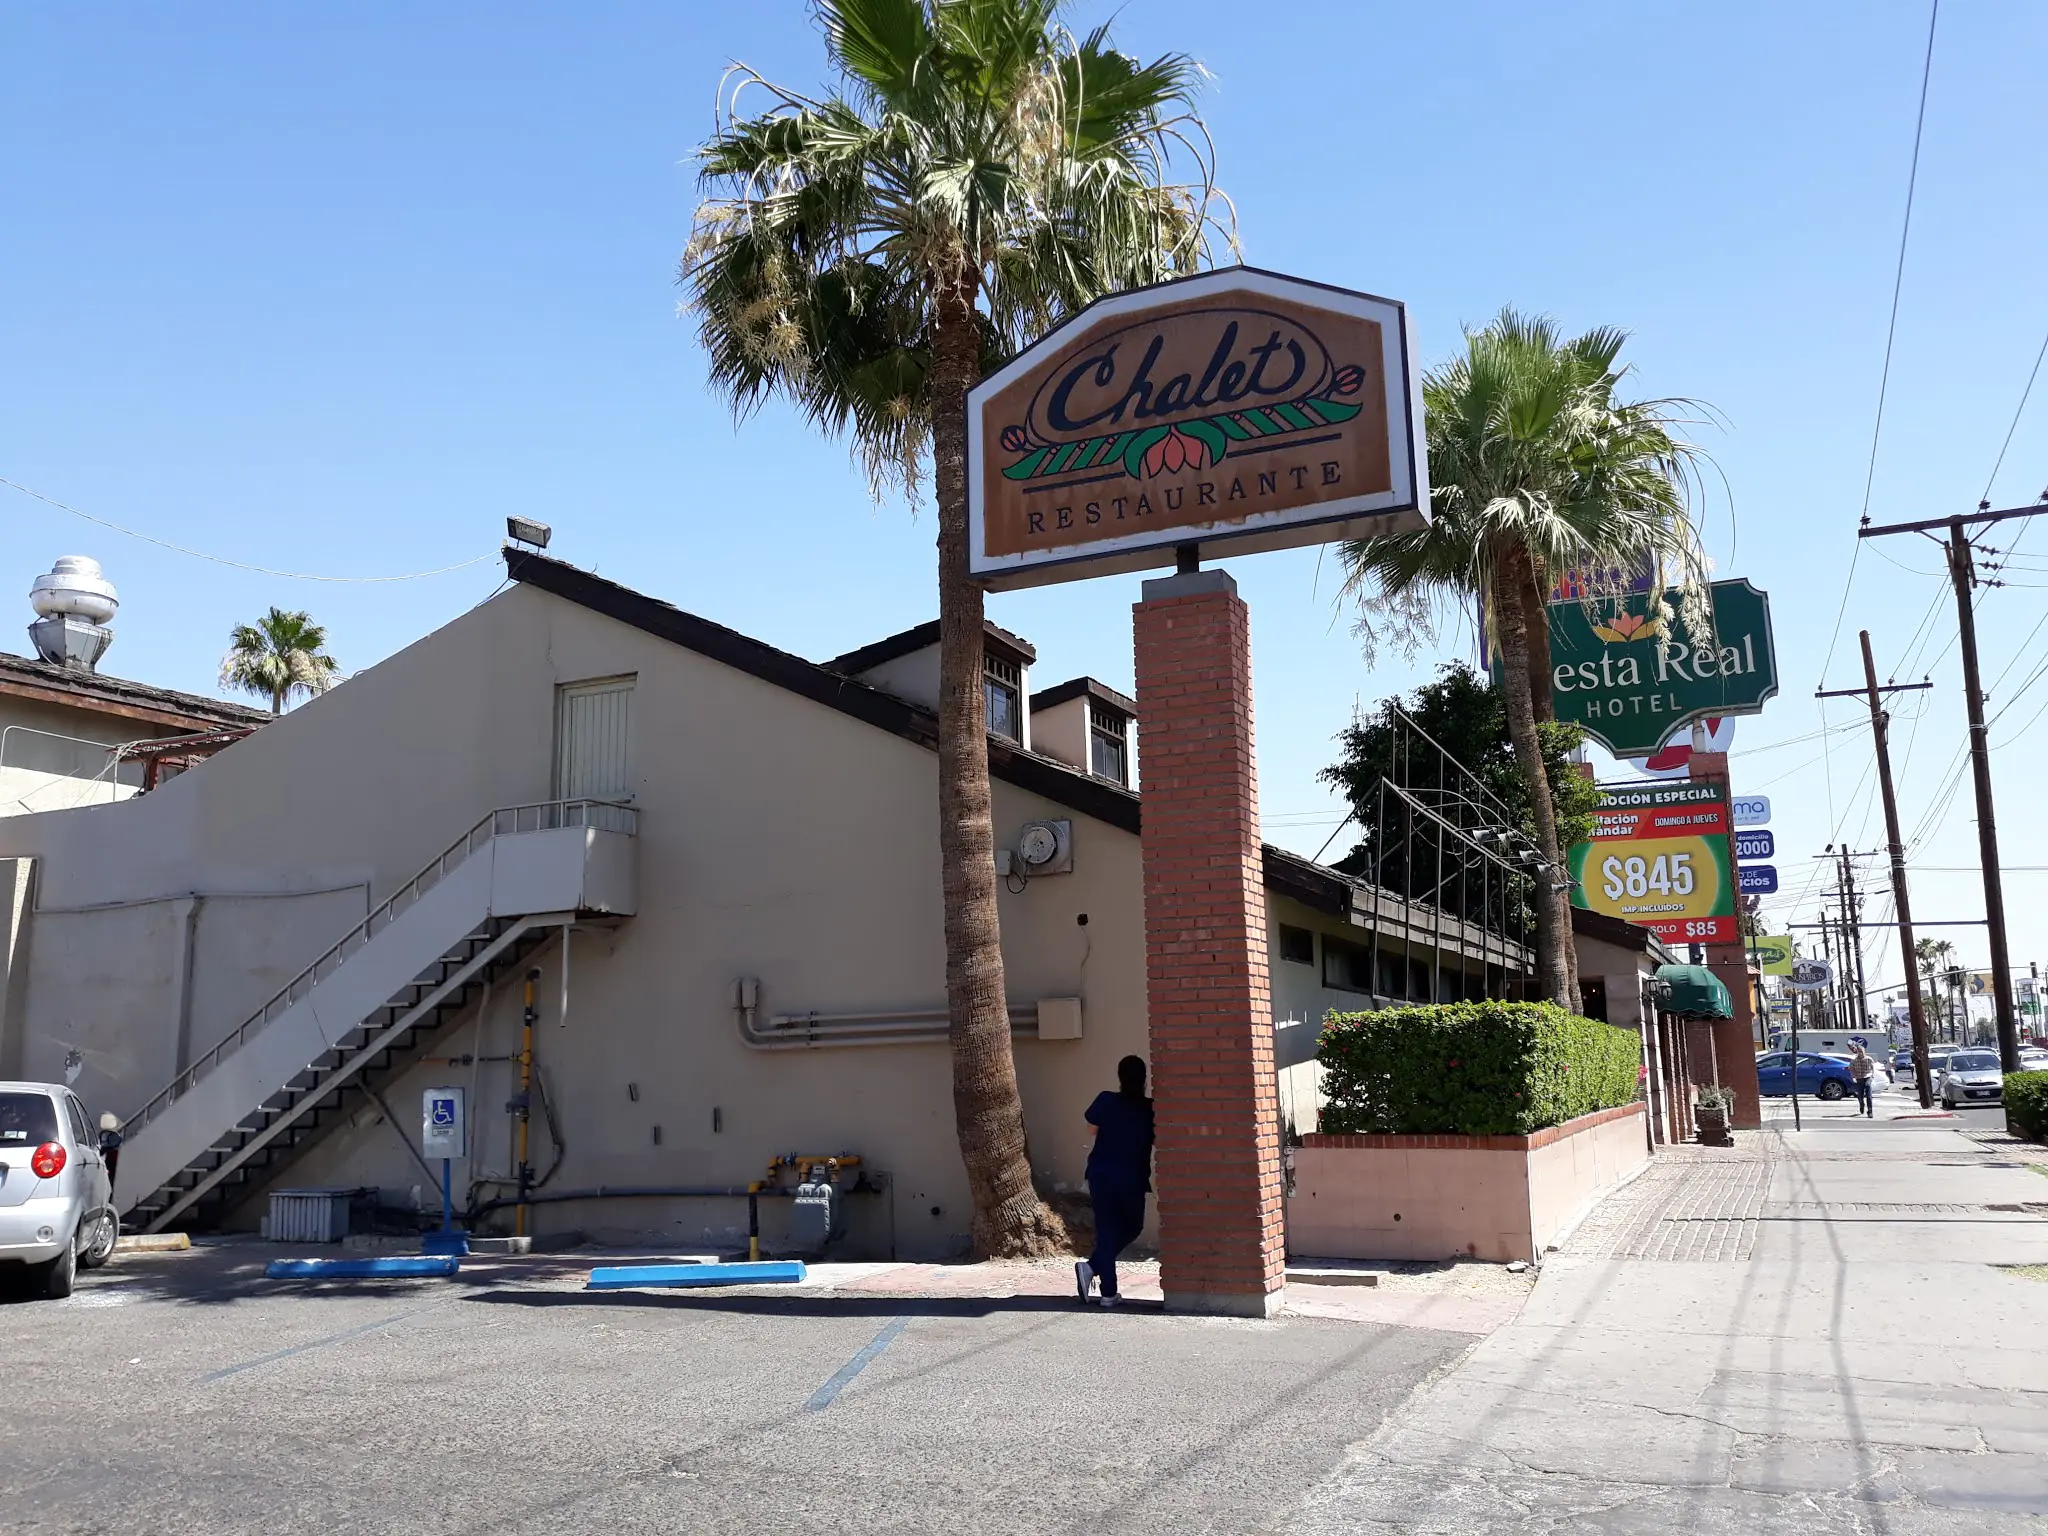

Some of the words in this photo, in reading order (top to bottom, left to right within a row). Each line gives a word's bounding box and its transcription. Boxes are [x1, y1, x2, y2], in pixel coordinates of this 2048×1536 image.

[1048, 321, 1305, 431] Chalet
[1028, 461, 1342, 534] RESTAURANTE
[1656, 633, 1756, 682] Real
[1586, 693, 1683, 718] HOTEL
[1656, 788, 1716, 802] ESPECIAL
[1654, 817, 1686, 827] DOMINGO
[1693, 814, 1718, 825] JUEVES
[1602, 854, 1693, 900] $845
[1650, 925, 1677, 934] SOLO
[1685, 921, 1717, 937] $85
